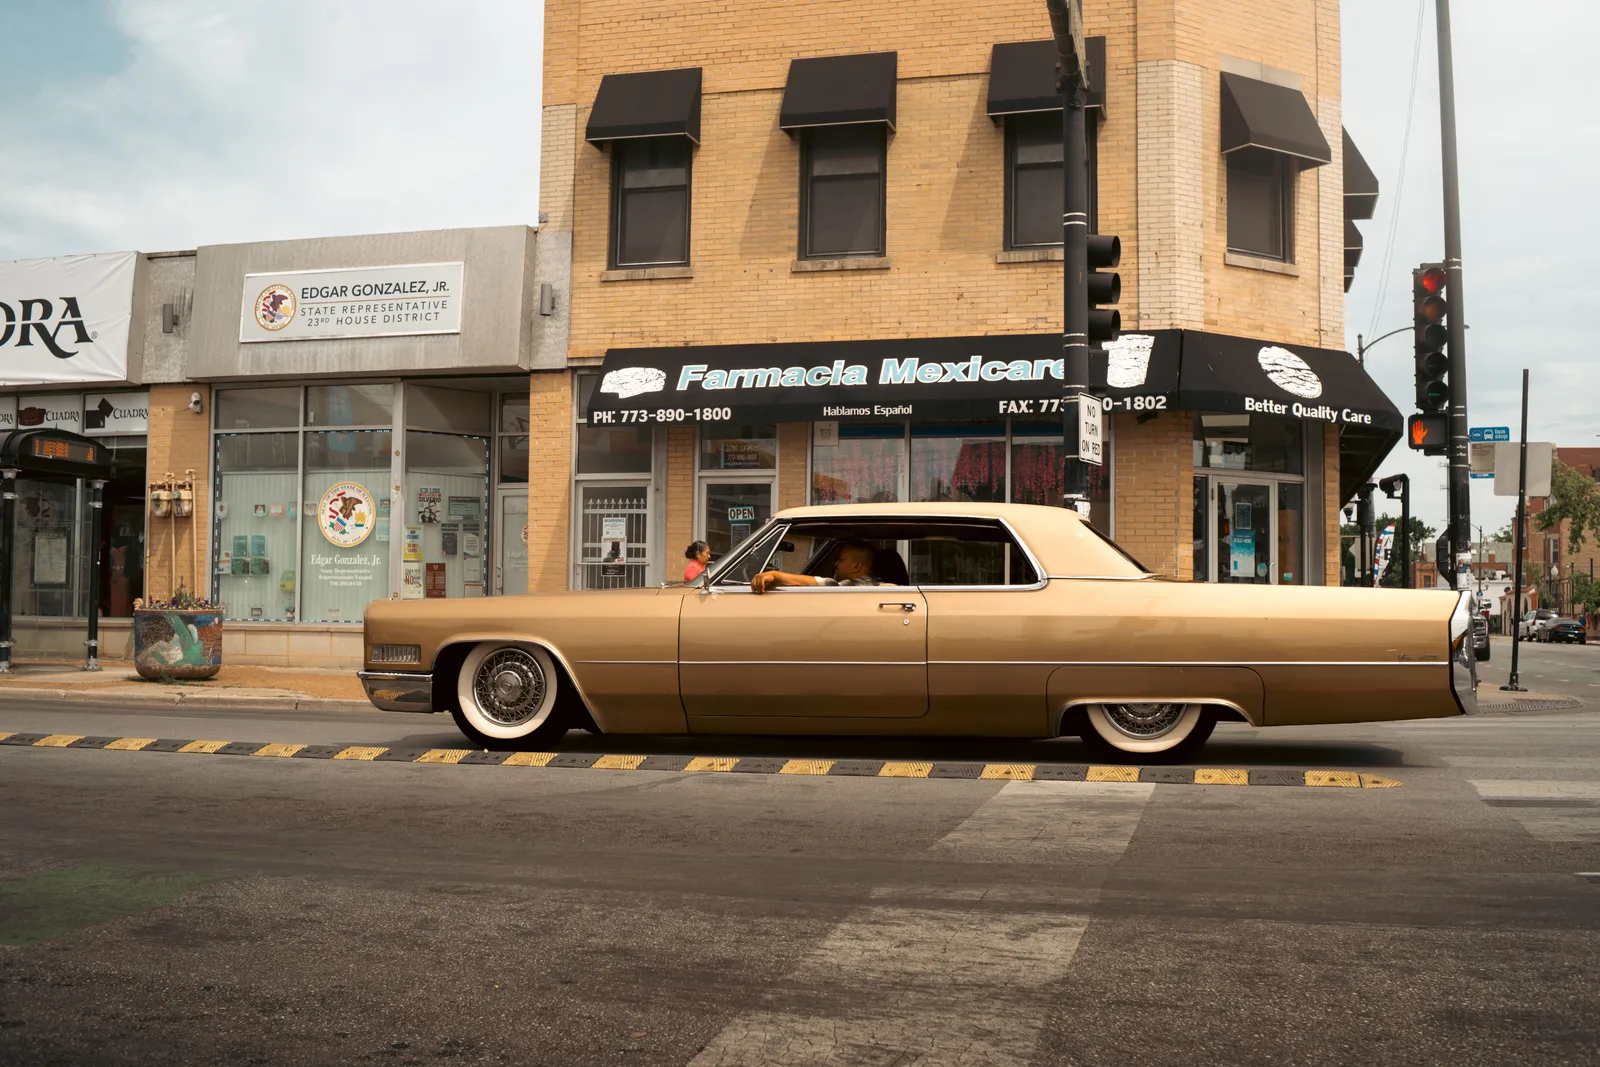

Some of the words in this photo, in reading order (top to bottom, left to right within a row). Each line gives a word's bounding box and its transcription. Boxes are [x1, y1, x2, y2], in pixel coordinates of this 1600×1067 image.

[300, 285, 348, 299] EDGAR
[351, 280, 429, 297] GONZALEZ,
[432, 281, 450, 292] JR.
[300, 306, 336, 316] STATE
[342, 301, 448, 314] REPRESENTATIVE
[307, 317, 330, 327] 23RD
[336, 315, 377, 325] HOUSE
[383, 312, 440, 323] DISTRICT
[675, 360, 869, 391] Farmacia
[823, 405, 871, 416] Hablamos
[874, 404, 913, 417] Español
[998, 399, 1034, 414] FAX:
[1087, 404, 1096, 418] NO
[1244, 397, 1288, 414] Better
[1292, 402, 1338, 423] Quality
[1342, 408, 1372, 424] Care
[593, 411, 616, 424] PH:
[620, 407, 732, 423] 773-890-1800
[1085, 421, 1098, 437] TURN
[1081, 440, 1090, 452] ON
[1092, 442, 1101, 456] RED
[729, 508, 753, 519] OPEN
[311, 554, 333, 567] Edgar
[334, 554, 370, 566] Gonzalez,
[372, 554, 381, 566] Jr.
